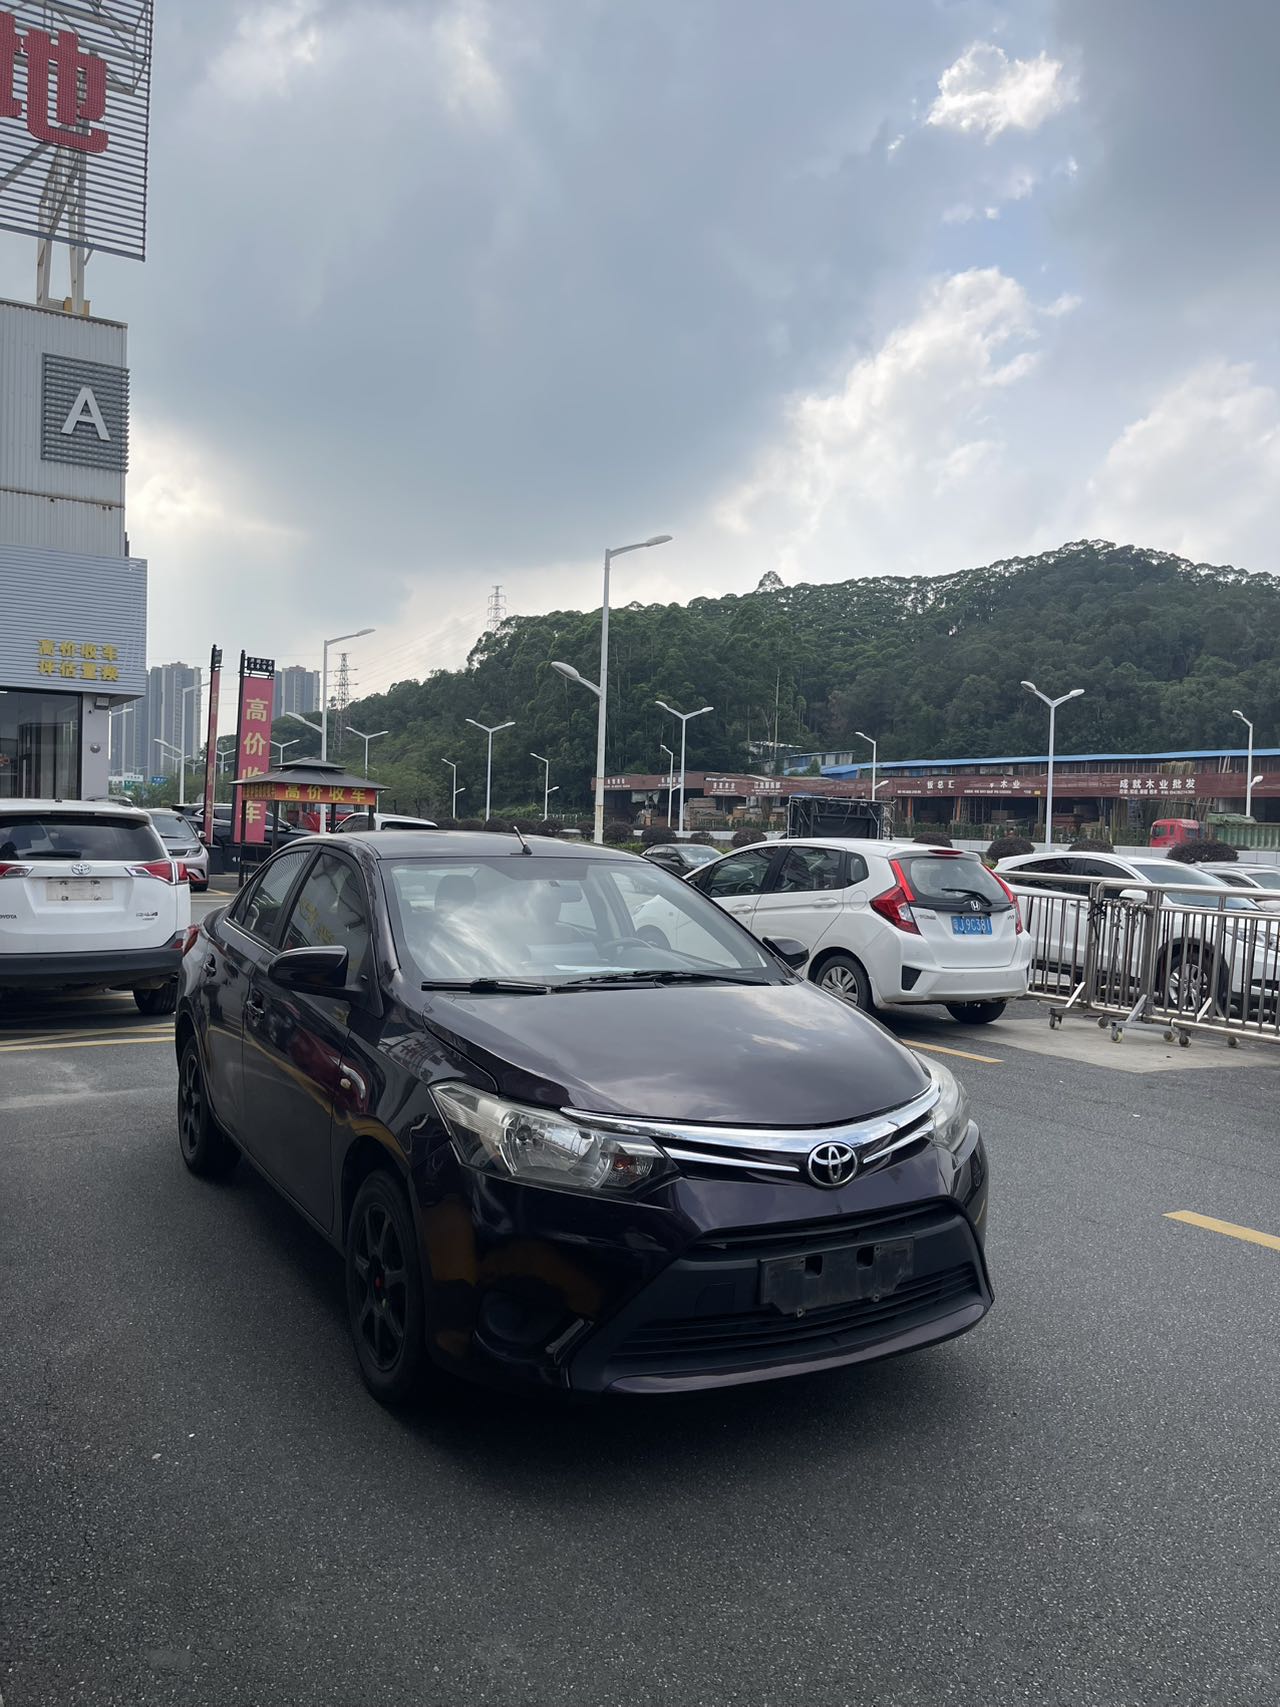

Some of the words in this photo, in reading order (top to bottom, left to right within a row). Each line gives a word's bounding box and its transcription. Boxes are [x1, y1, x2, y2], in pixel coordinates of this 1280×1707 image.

[60, 386, 111, 441] A
[285, 784, 367, 802] 高价收车
